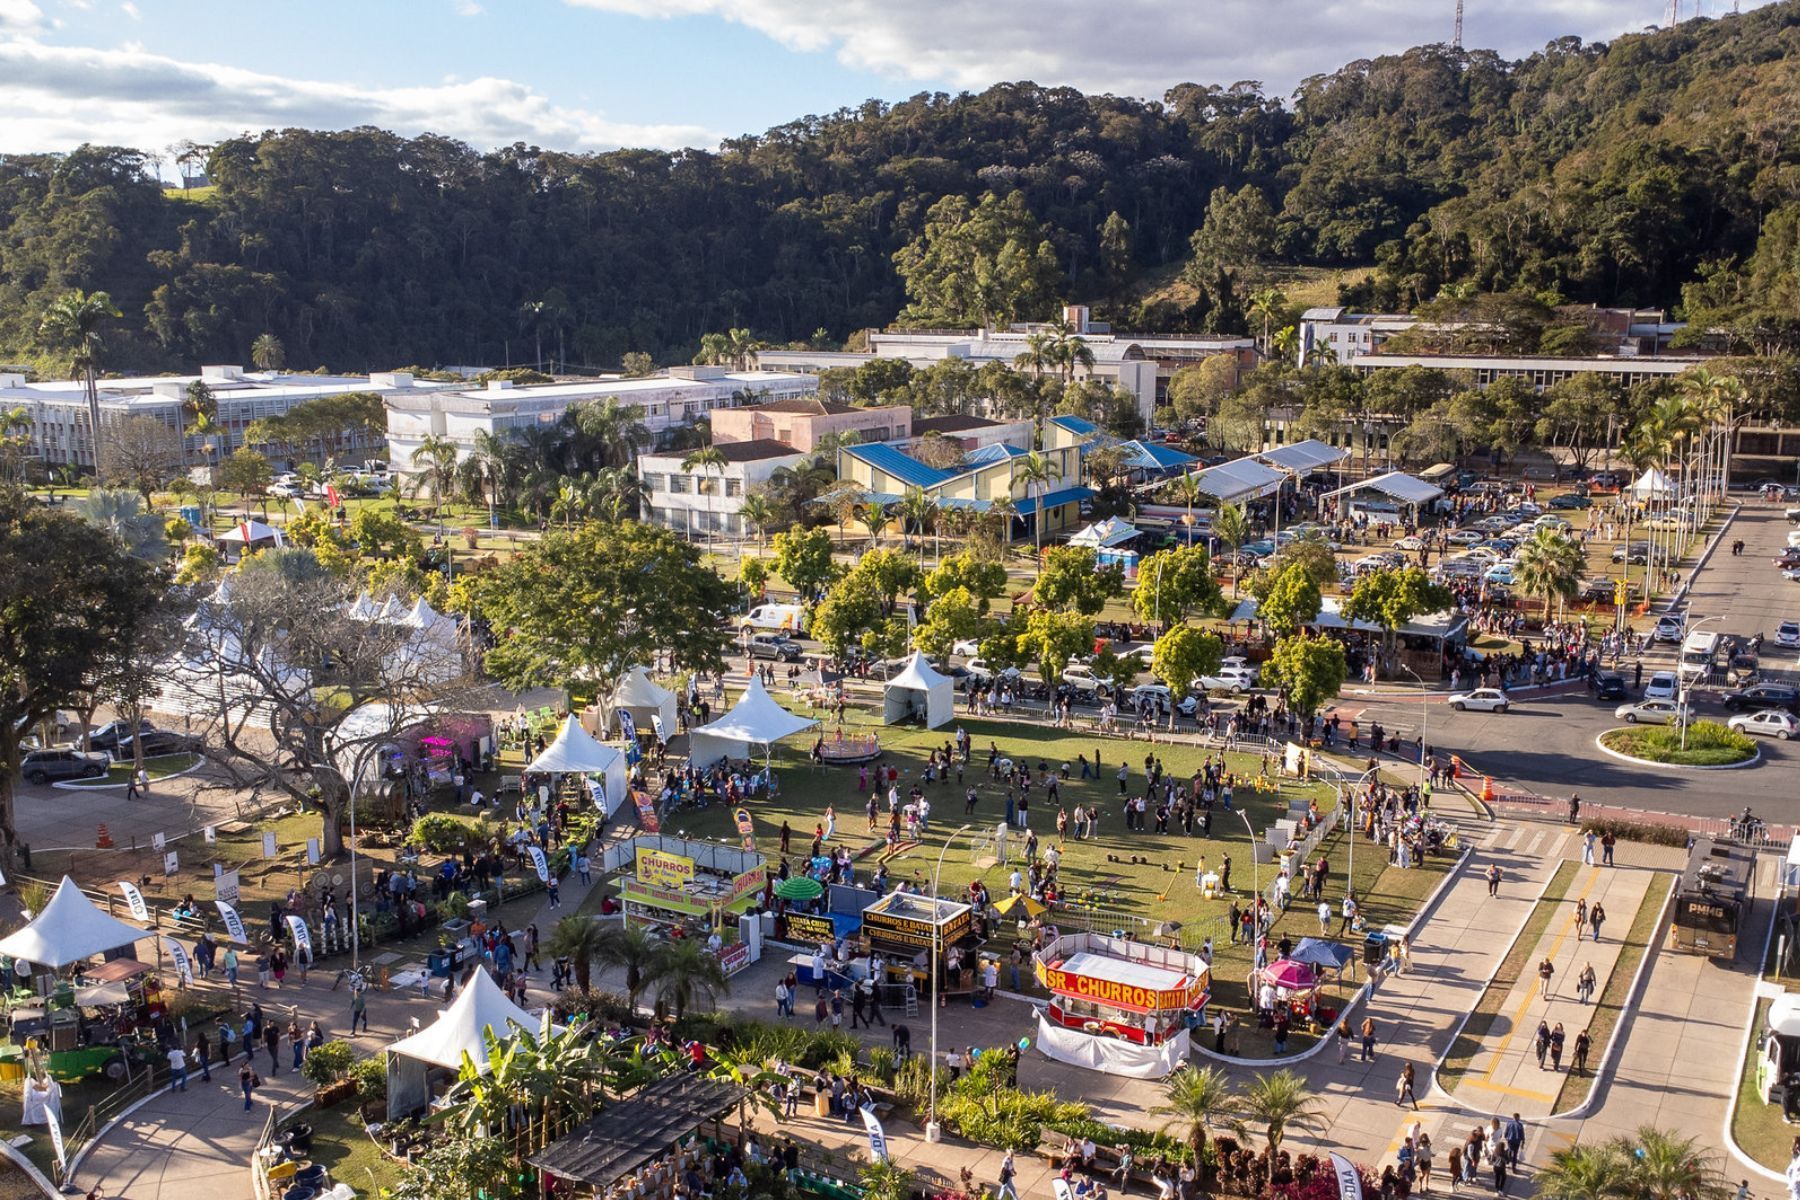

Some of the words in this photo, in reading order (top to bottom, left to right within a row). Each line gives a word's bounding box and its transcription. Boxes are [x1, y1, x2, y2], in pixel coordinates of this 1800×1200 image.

[641, 856, 690, 875] CHURROS
[1689, 903, 1724, 917] PMMG
[225, 910, 239, 931] DAA
[866, 913, 901, 927] CHURROS
[296, 922, 307, 941] DAA
[173, 946, 184, 966] DAA
[1077, 976, 1156, 1009] CHURROS
[1158, 991, 1185, 1008] BATATA
[870, 1124, 882, 1148] DAA
[1341, 1170, 1356, 1193] DAA
